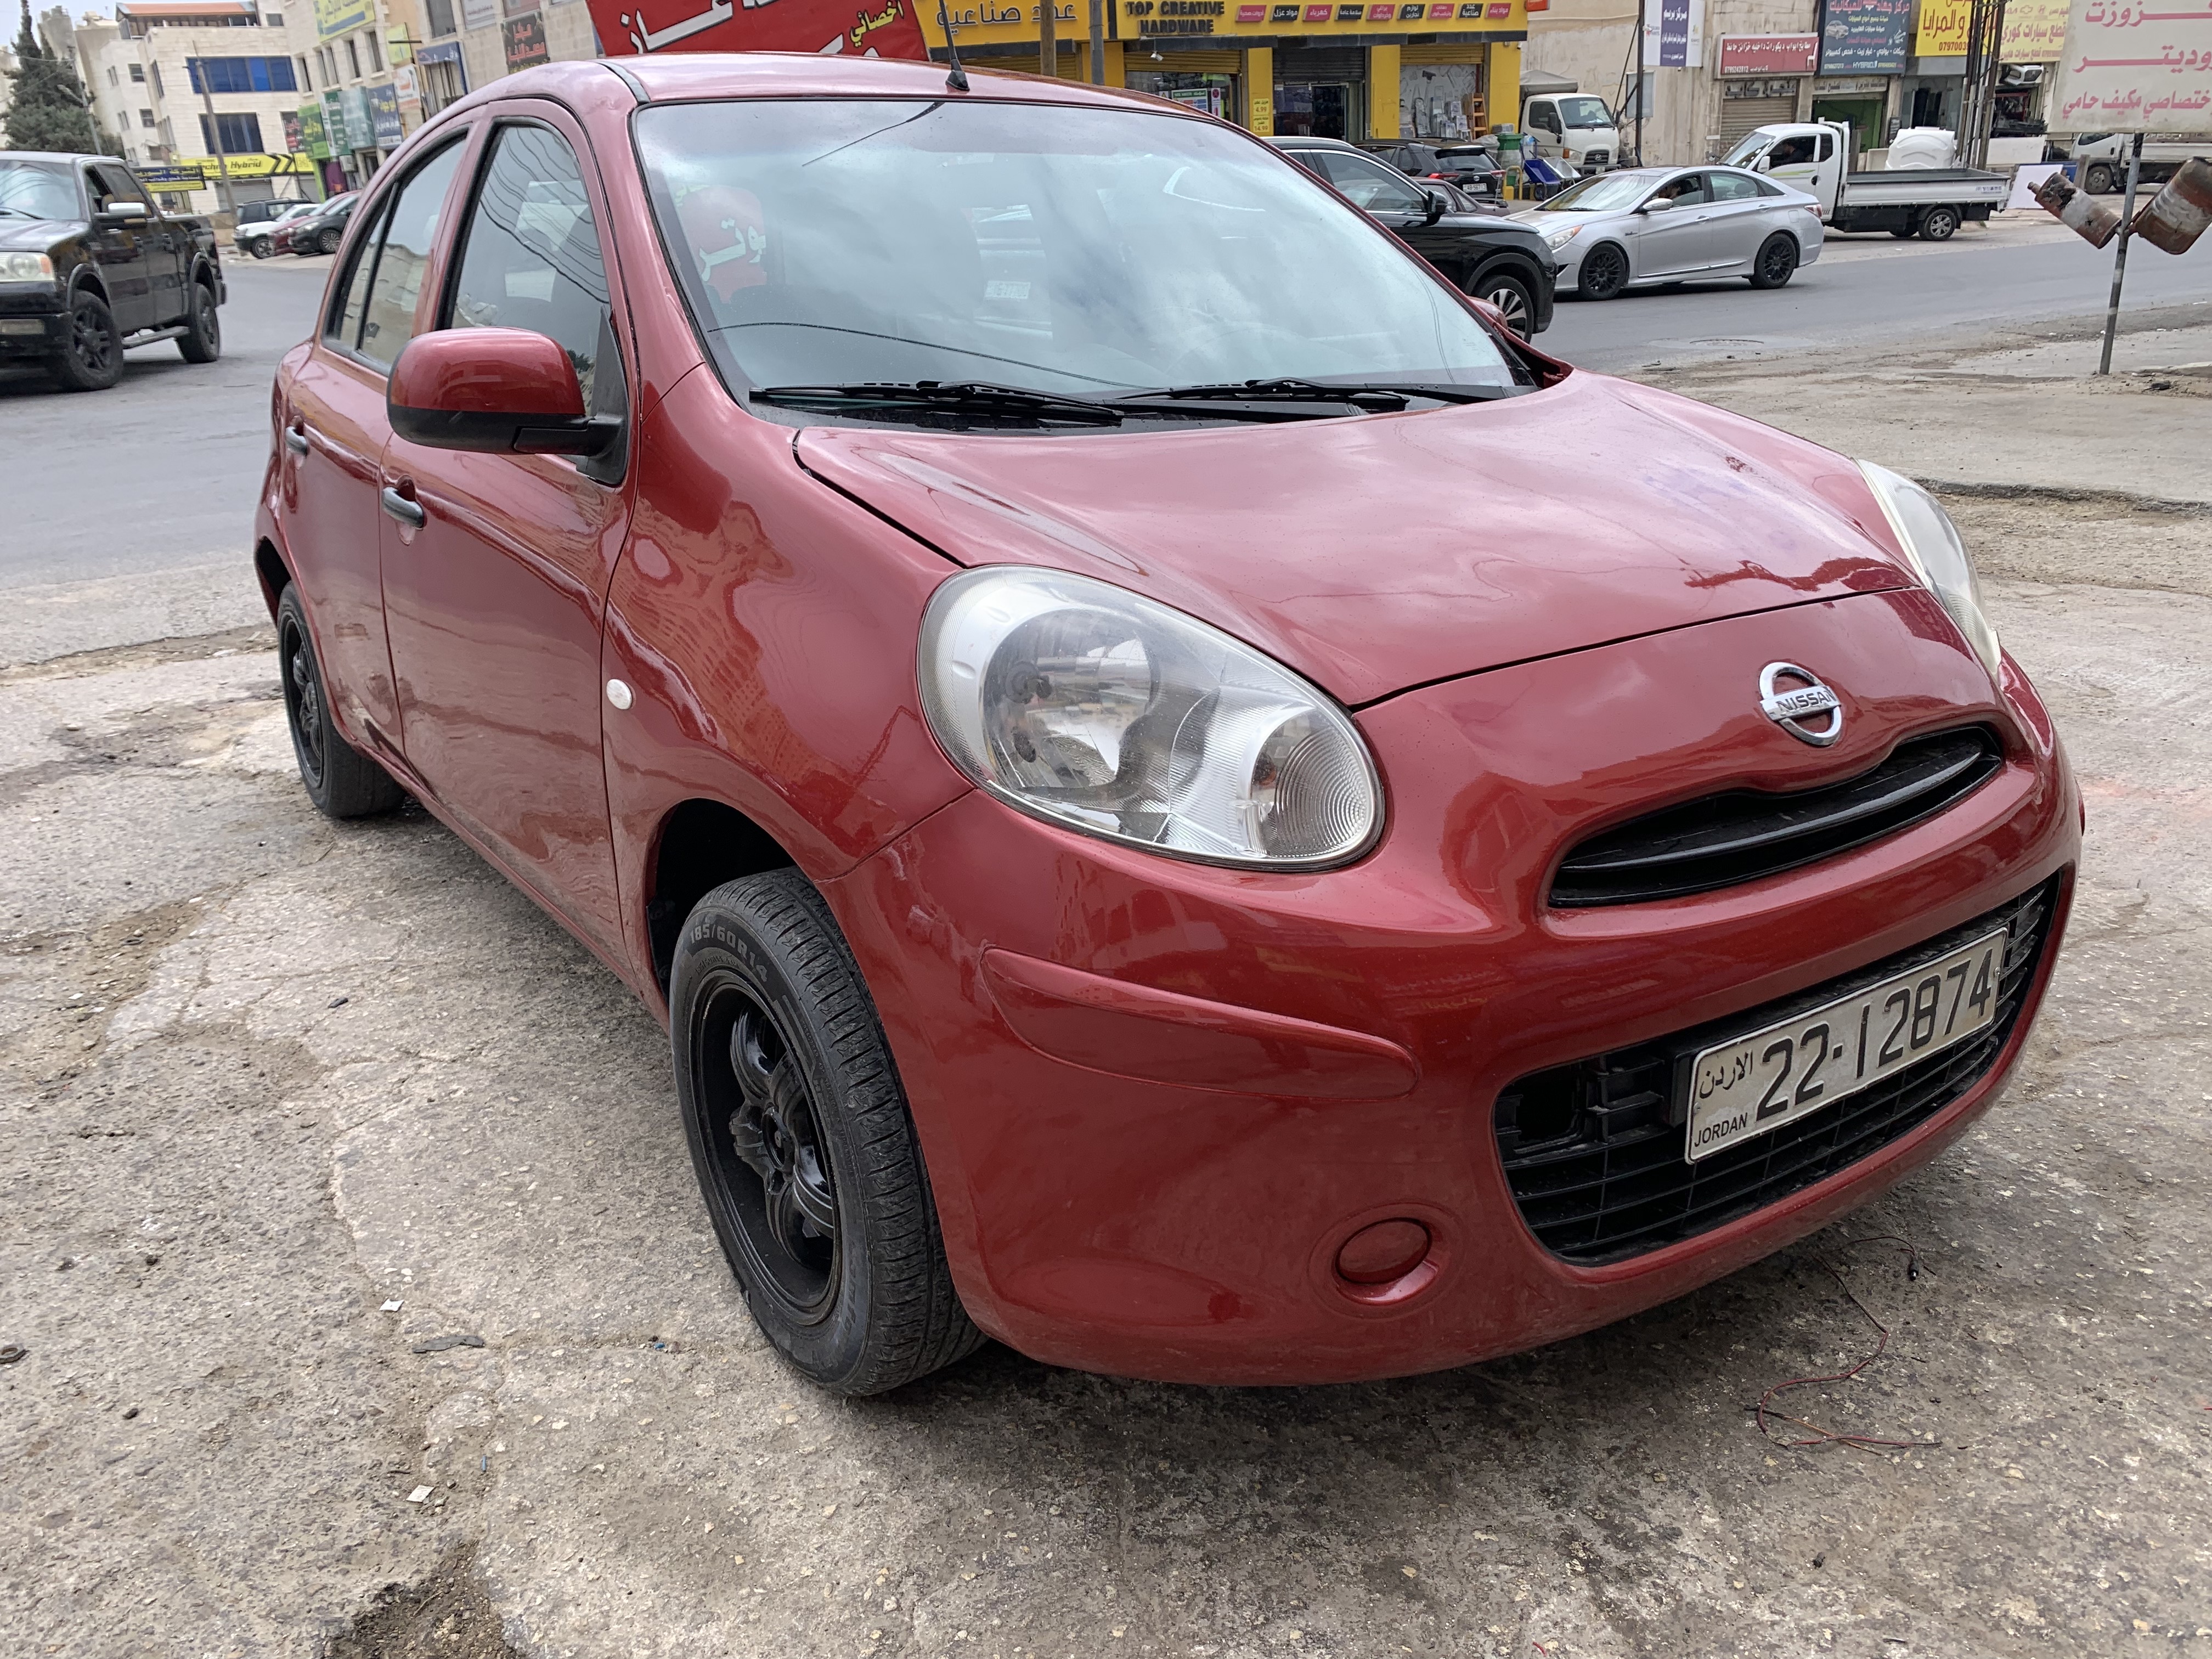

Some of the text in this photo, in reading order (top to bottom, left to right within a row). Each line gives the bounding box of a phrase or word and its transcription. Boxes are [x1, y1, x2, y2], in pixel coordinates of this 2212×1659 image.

[1126, 1, 1224, 15] TOP CREATIVE
[1274, 9, 1298, 17] مواد عزل
[1462, 9, 1480, 18] صناعية
[1139, 19, 1214, 33] HARDWARE
[1923, 9, 1956, 39] المرايا
[2023, 22, 2048, 42] سيارات
[2072, 45, 2212, 74] وديتر
[2063, 91, 2100, 120] حامي
[2102, 89, 2142, 115] مكيف
[230, 161, 262, 170] Hybrid
[1775, 689, 1837, 712] NISSAN
[690, 923, 768, 983] 185/60R14
[1756, 947, 1994, 1122] 22-12874
[1700, 1049, 1753, 1099] الاردن
[1694, 1111, 1748, 1148] JORDAN
